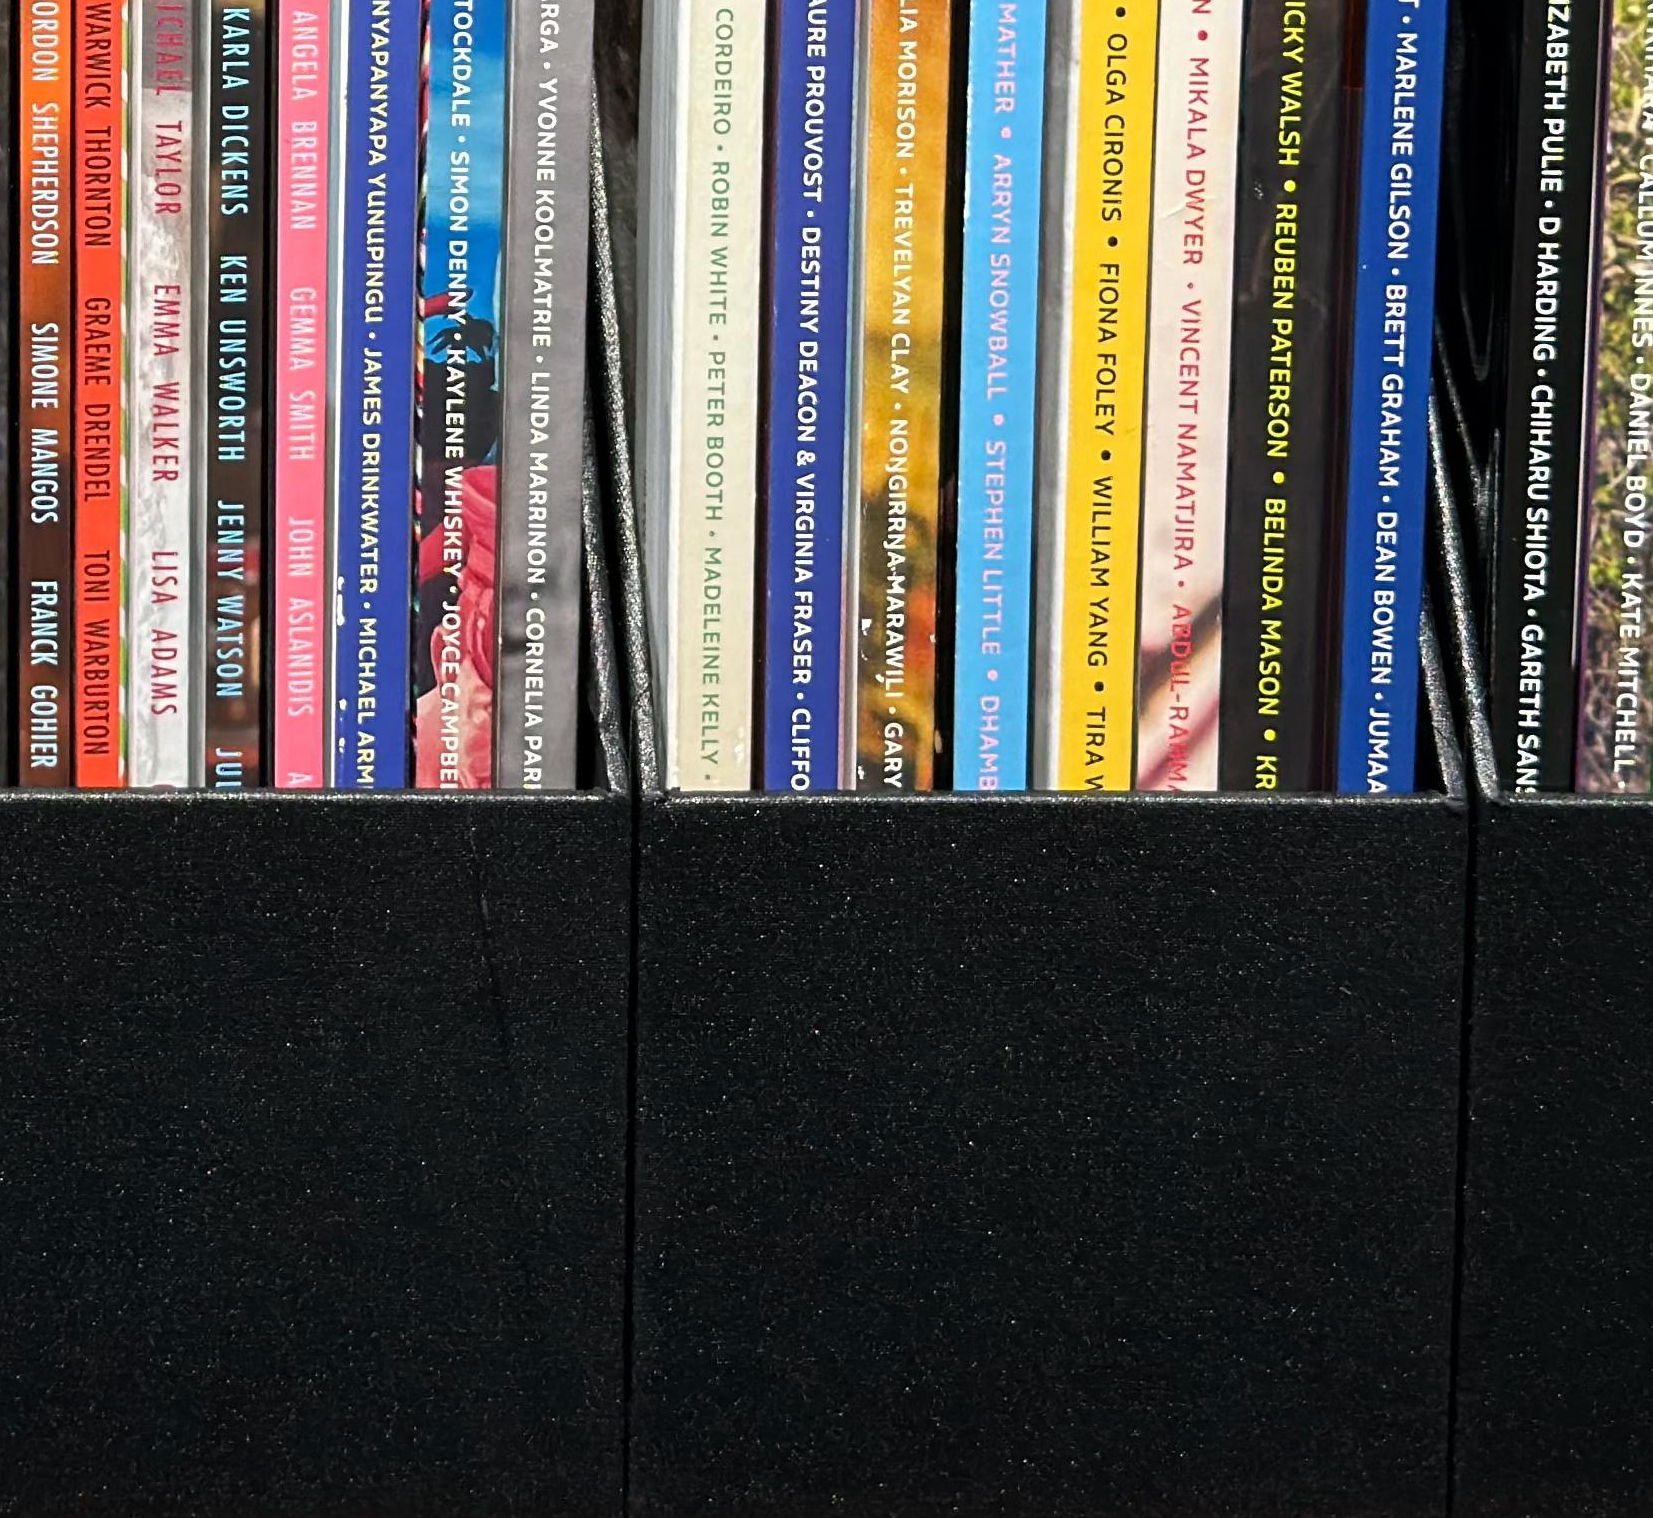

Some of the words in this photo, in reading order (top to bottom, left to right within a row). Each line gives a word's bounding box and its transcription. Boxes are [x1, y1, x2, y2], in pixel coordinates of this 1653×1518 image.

[220, 256, 247, 302] KEN
[800, 228, 821, 333] DESTINY
[893, 183, 913, 324] TREVELYAN
[1273, 204, 1297, 308] REUBEN
[85, 298, 111, 385] GRAEME
[363, 348, 382, 425] JAMES
[891, 333, 910, 394] CLAY
[218, 320, 246, 459] UNSWORTH
[530, 373, 550, 444] LINDA
[707, 352, 725, 426] PETER
[798, 342, 818, 441] DEACON
[1267, 319, 1292, 457] PATERSON
[84, 404, 110, 502] DRENDEL
[706, 437, 724, 520] BOOTH
[797, 450, 815, 466] &
[1528, 385, 1553, 500] CHIHARU
[360, 434, 380, 593] DRINKWATER
[528, 453, 548, 583] MARRINON
[795, 473, 815, 583] VIRGINIA
[984, 441, 1006, 559] STEPHEN
[1091, 476, 1112, 586] WILLIAM
[152, 552, 178, 603] LISA
[1375, 512, 1397, 581] DEAN
[1524, 508, 1549, 600] SHIOTA
[31, 581, 58, 665] FRANCK
[793, 592, 812, 683] FRASER
[982, 570, 1002, 654] LITTLE
[1088, 598, 1109, 666] YANG
[1371, 591, 1394, 683] BOWEN
[1618, 573, 1643, 637] KATE
[151, 629, 177, 715] ADAMS
[1613, 645, 1640, 773] MITCHELL
[31, 686, 57, 767] GOHIER
